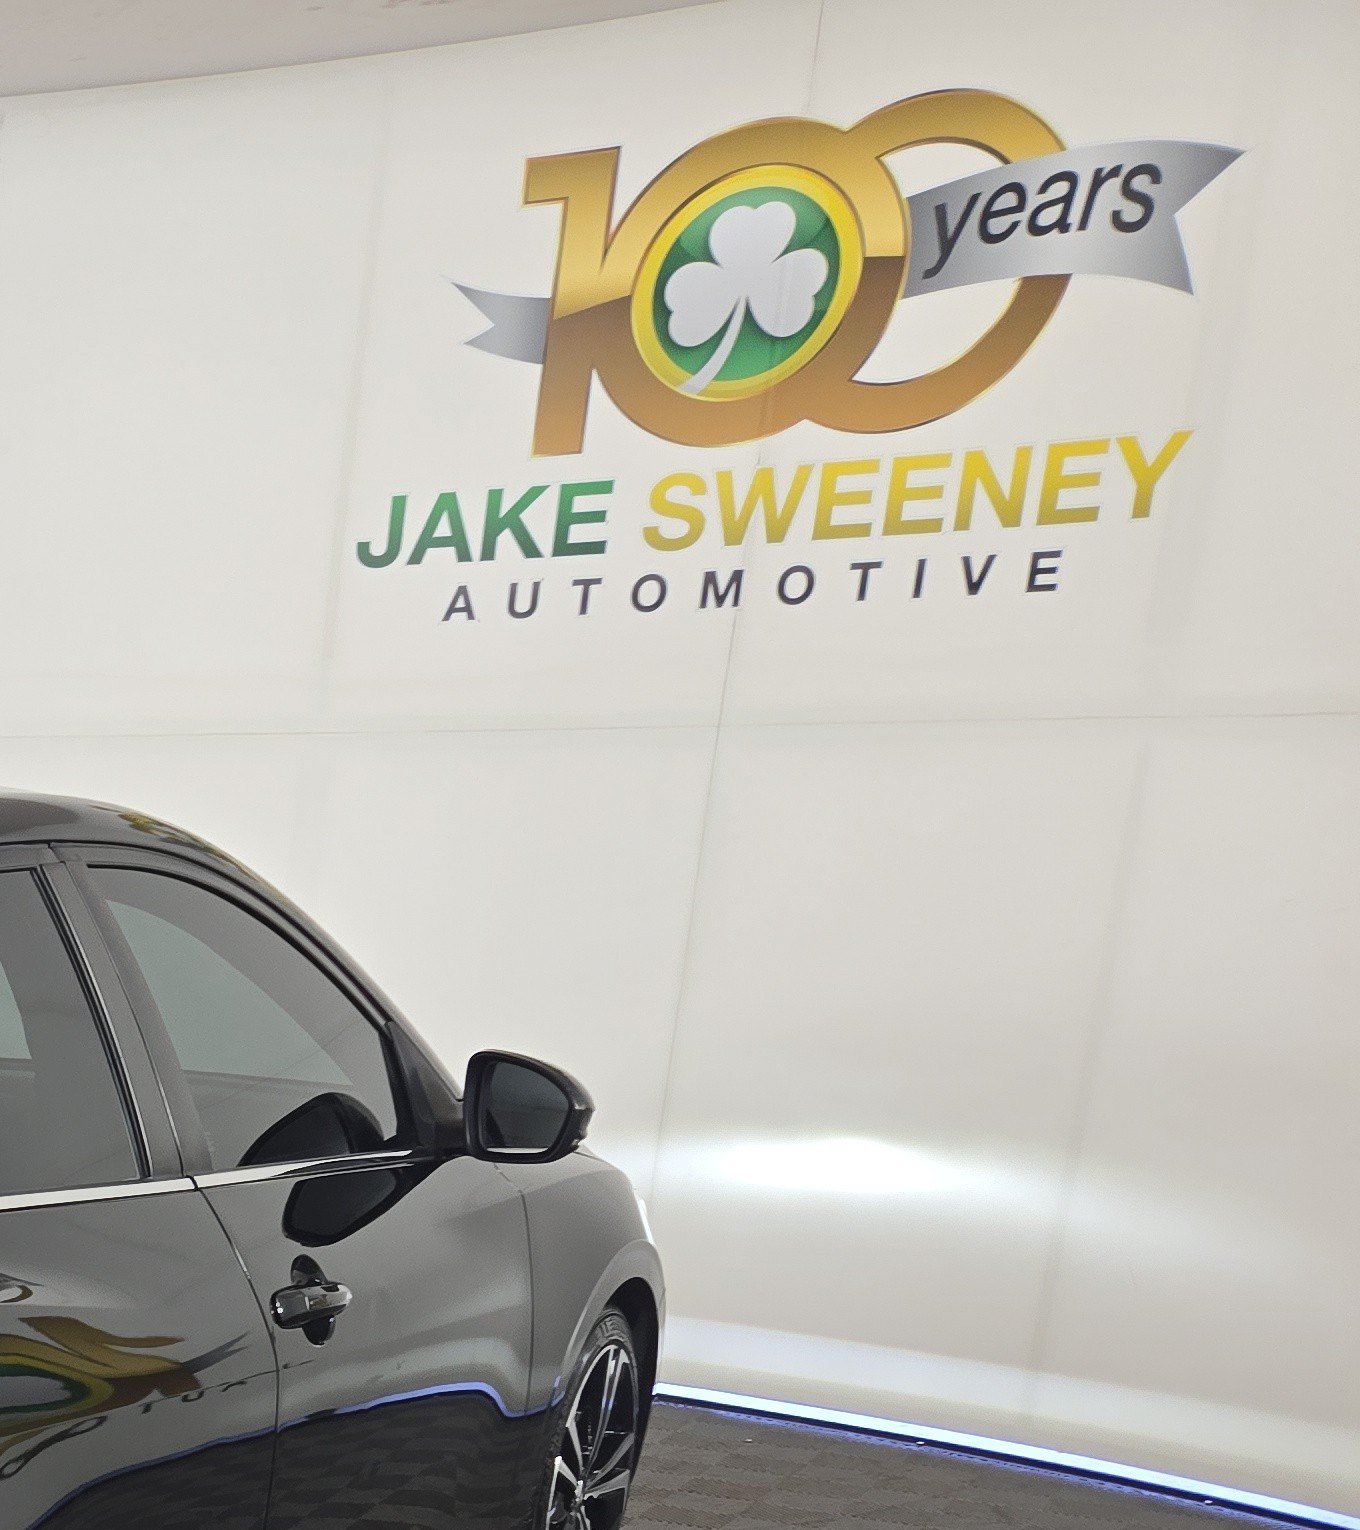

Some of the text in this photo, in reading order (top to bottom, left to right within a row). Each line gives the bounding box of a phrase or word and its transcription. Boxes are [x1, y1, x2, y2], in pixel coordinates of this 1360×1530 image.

[923, 161, 1163, 280] years
[355, 430, 1193, 569] JAKE SWEENEY
[441, 550, 1063, 623] AUTOMOTIVE
